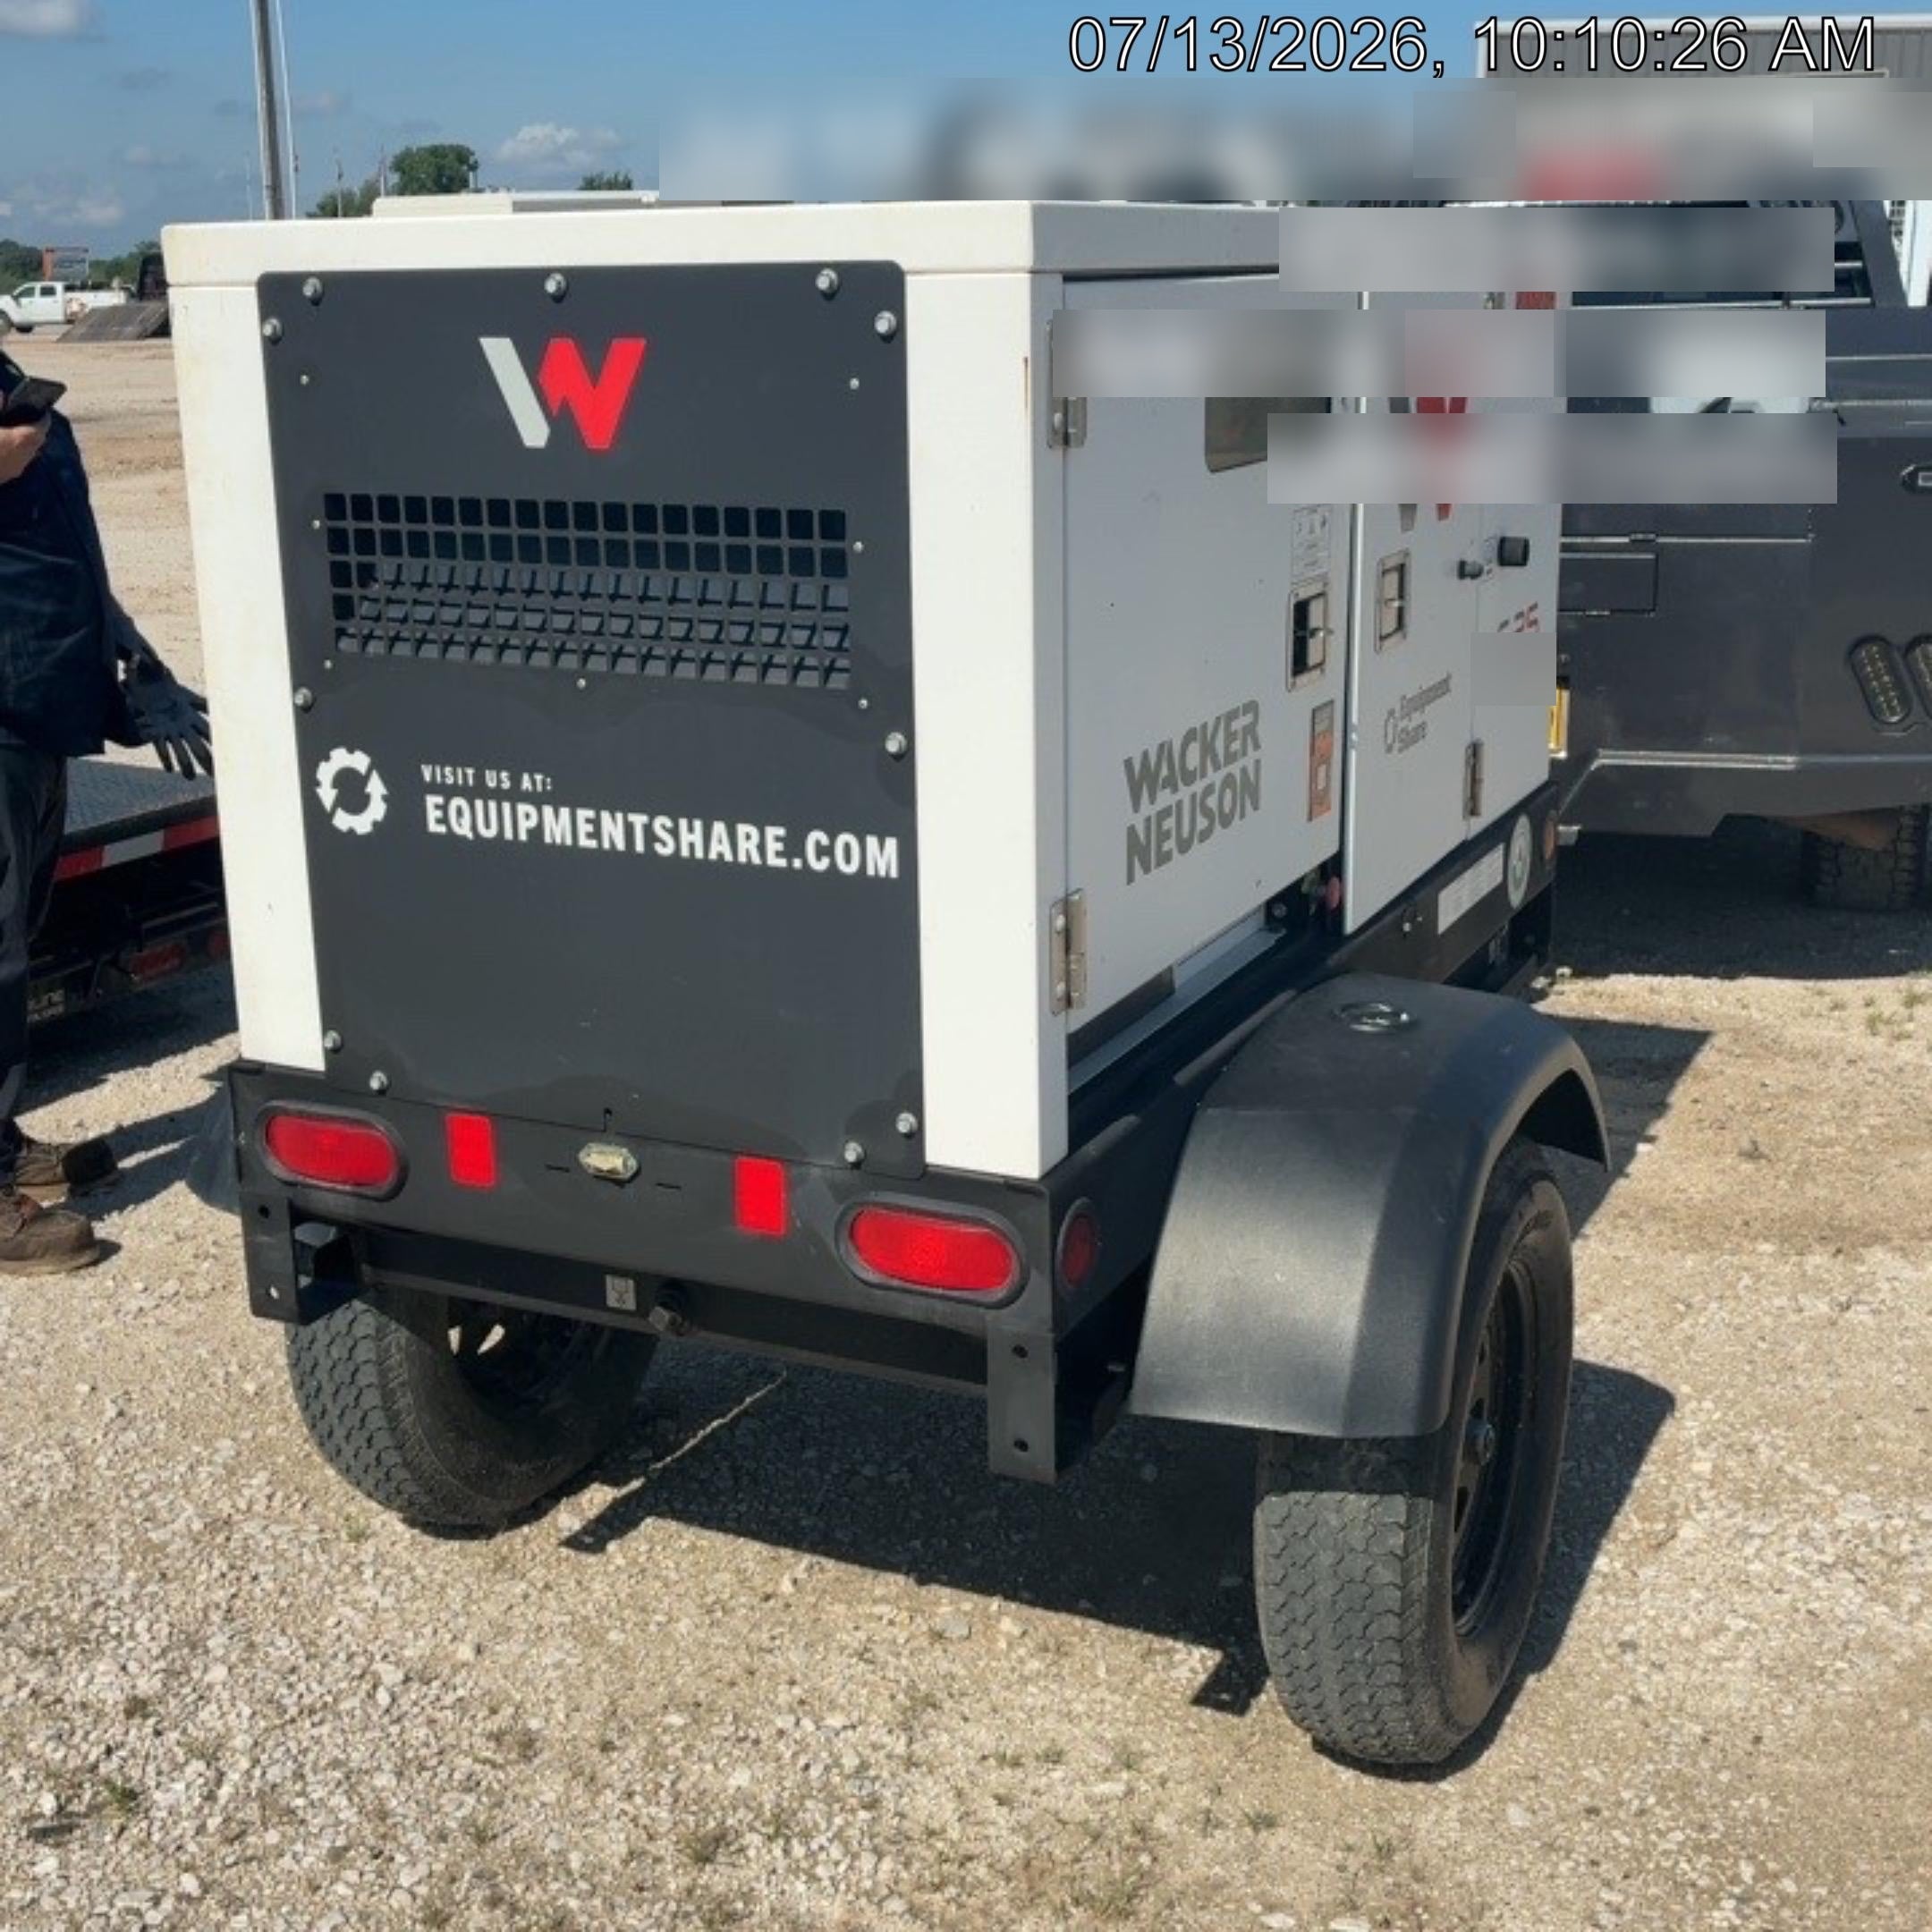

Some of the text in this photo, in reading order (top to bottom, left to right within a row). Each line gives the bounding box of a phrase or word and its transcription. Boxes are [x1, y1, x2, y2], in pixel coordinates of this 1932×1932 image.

[420, 764, 553, 792] VISIT US AT:
[1123, 699, 1262, 814] WACKER
[425, 793, 899, 879] EQUIPMENTSHARE.COM
[1126, 758, 1261, 886] NEUSON
